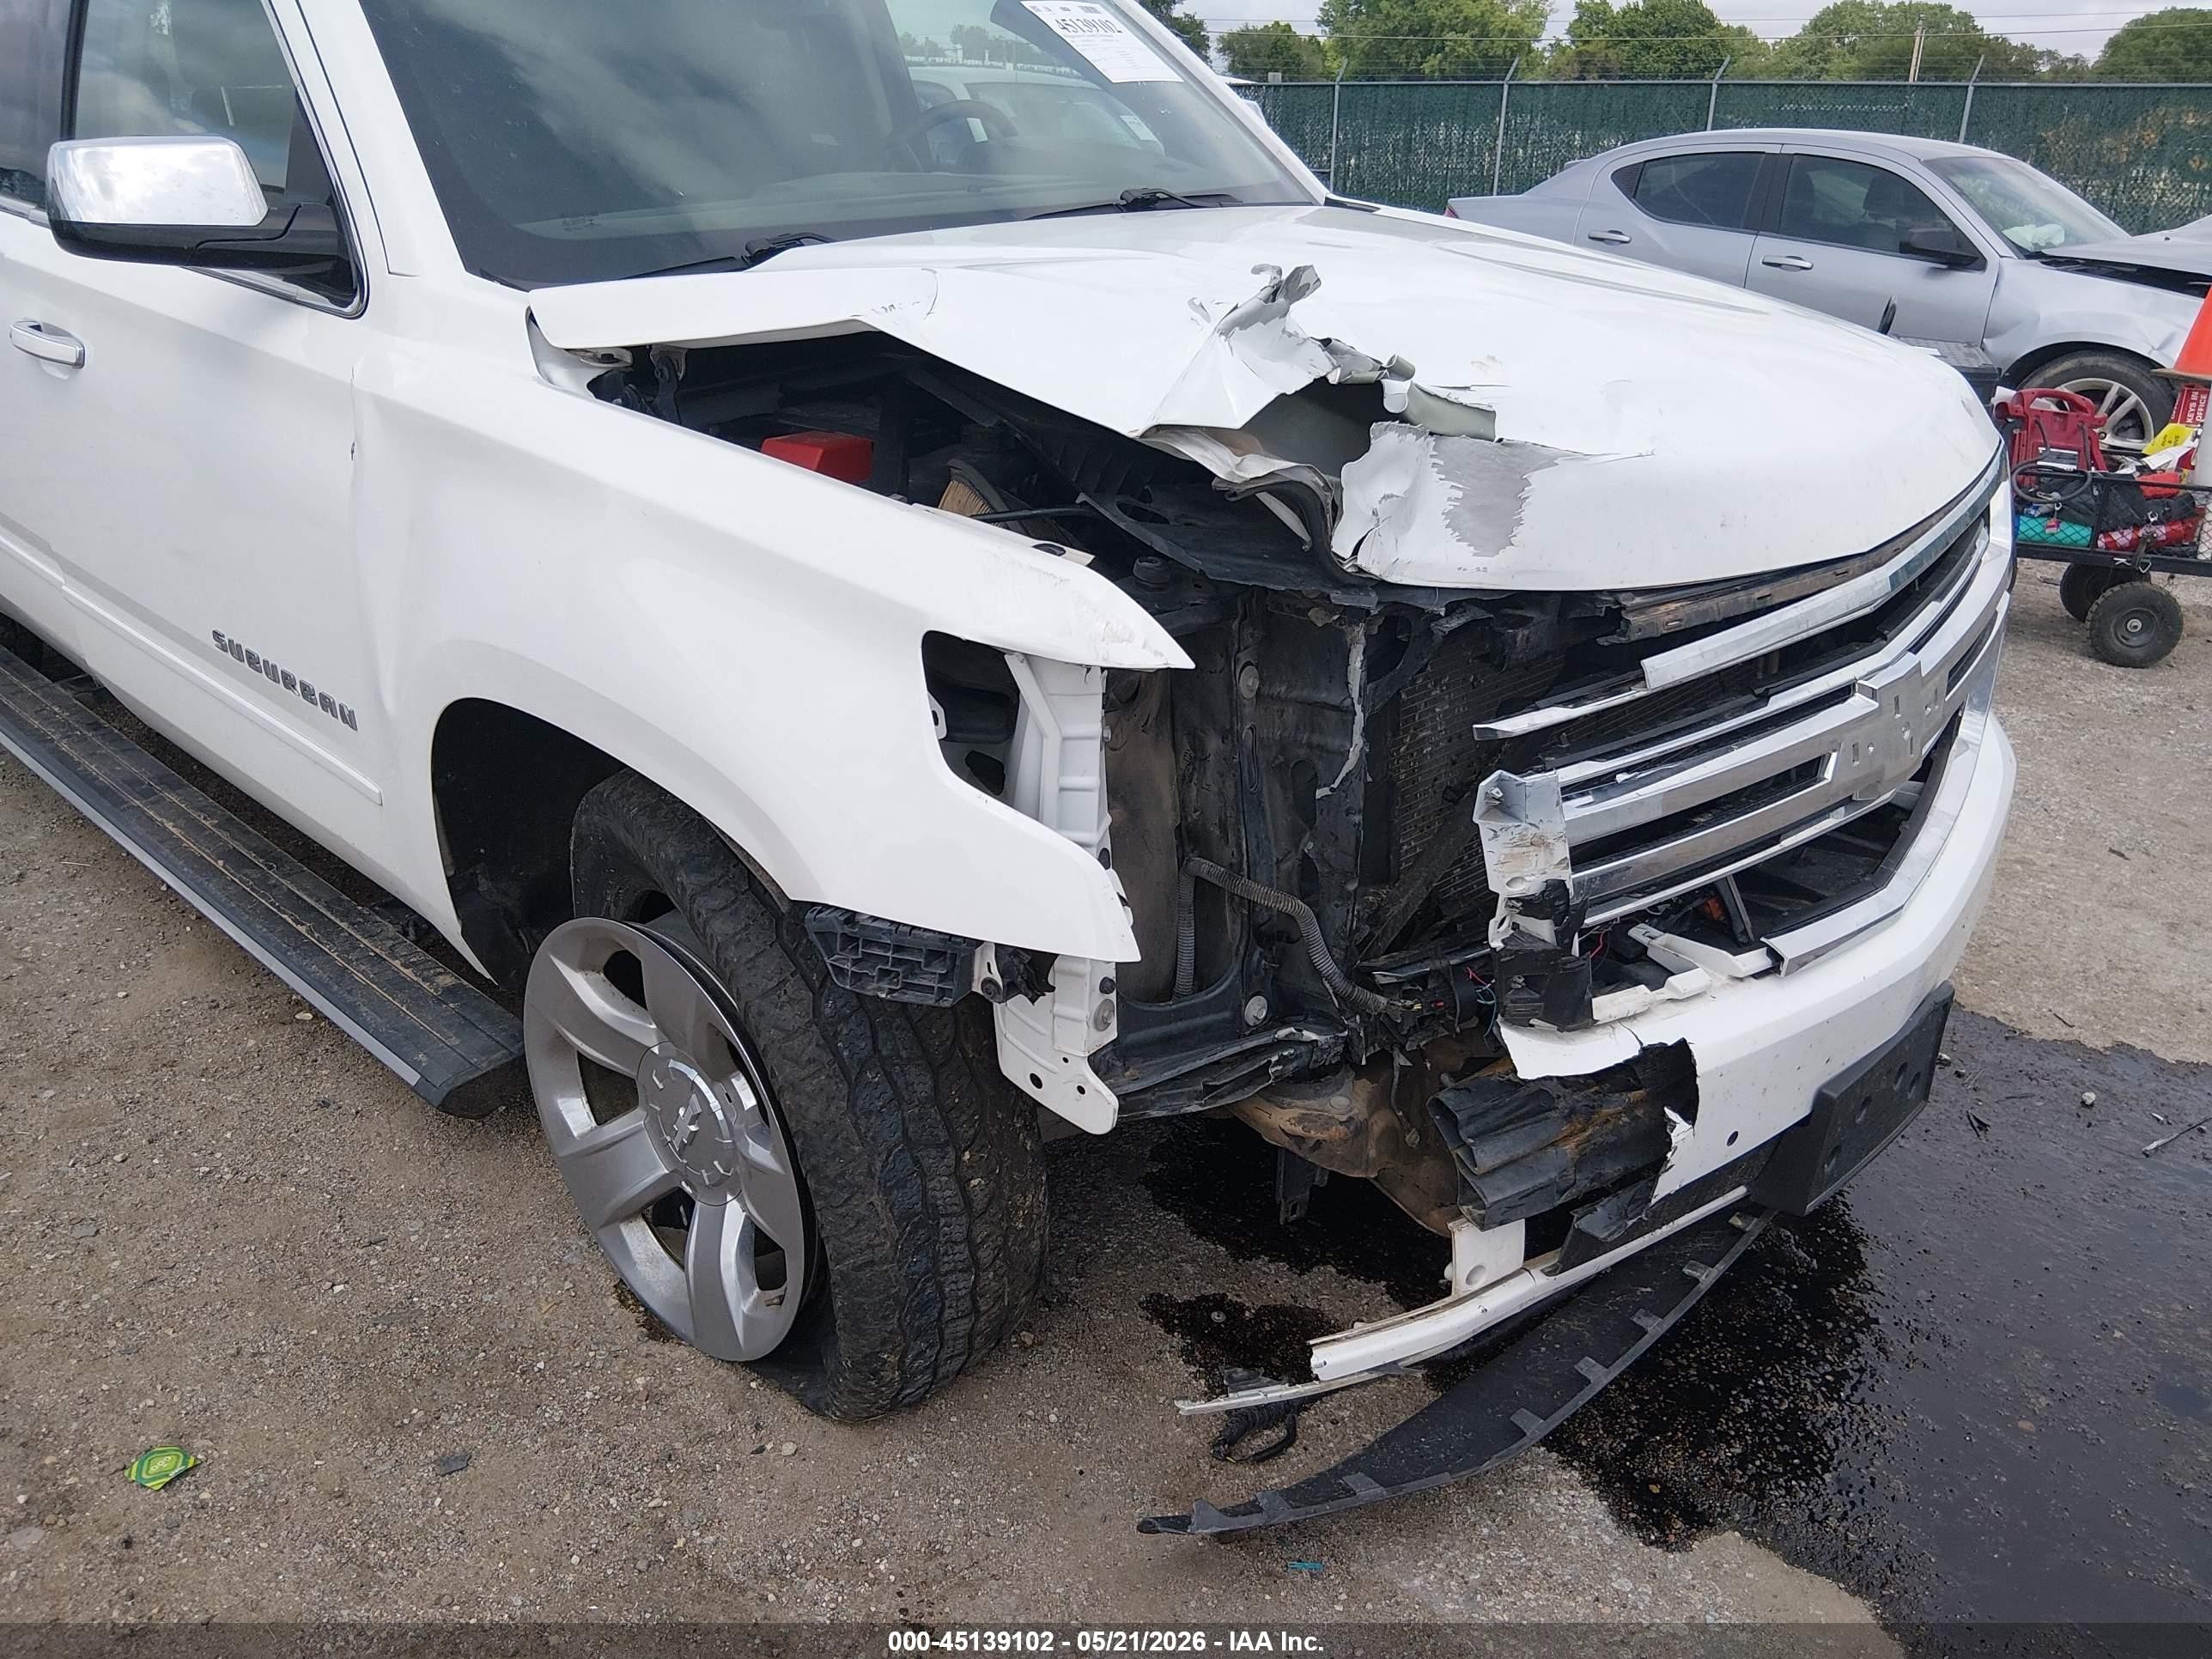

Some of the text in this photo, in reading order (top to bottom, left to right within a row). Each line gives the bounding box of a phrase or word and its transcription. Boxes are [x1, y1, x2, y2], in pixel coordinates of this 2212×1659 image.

[1054, 18, 1123, 34] 45139102
[2186, 391, 2199, 423] KEYS IN
[2195, 393, 2208, 420] OFFICE
[212, 629, 358, 732] SUBURBAN
